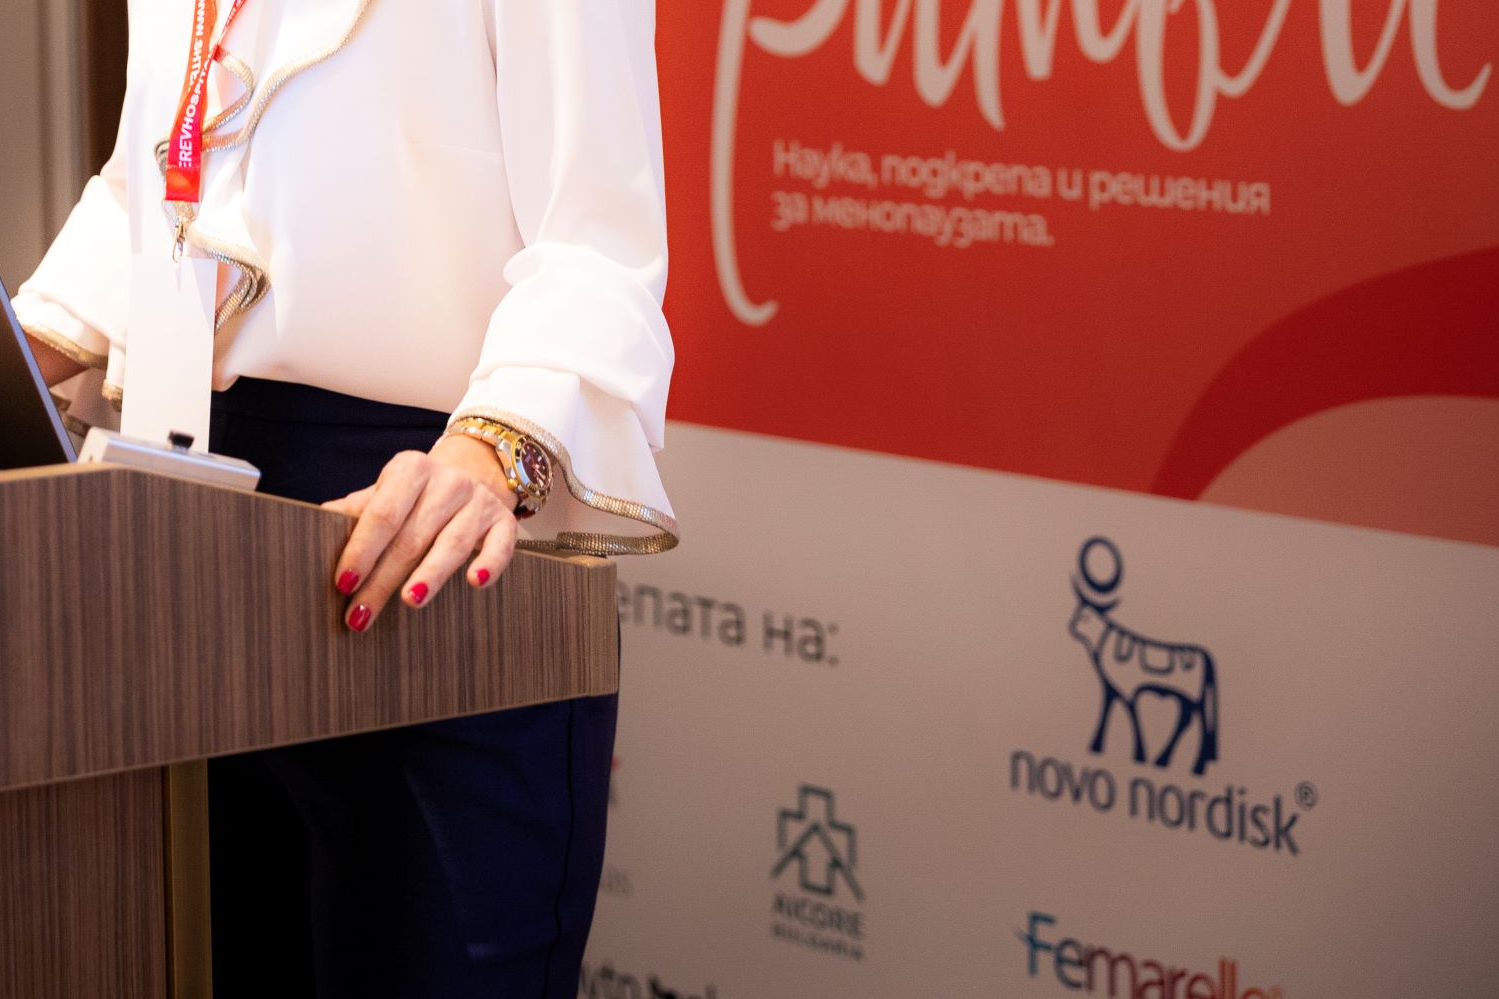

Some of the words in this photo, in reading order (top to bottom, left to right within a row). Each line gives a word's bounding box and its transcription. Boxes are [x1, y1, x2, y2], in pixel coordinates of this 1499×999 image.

[771, 137, 878, 190] Наука,
[880, 149, 1052, 201] подкрепа
[1057, 167, 1083, 201] и
[1088, 168, 1272, 215] решения
[771, 190, 808, 232] за
[812, 194, 1056, 249] менопаузата.
[762, 610, 839, 665] на:
[1009, 750, 1117, 812] novo
[1013, 911, 1268, 999] Femarell
